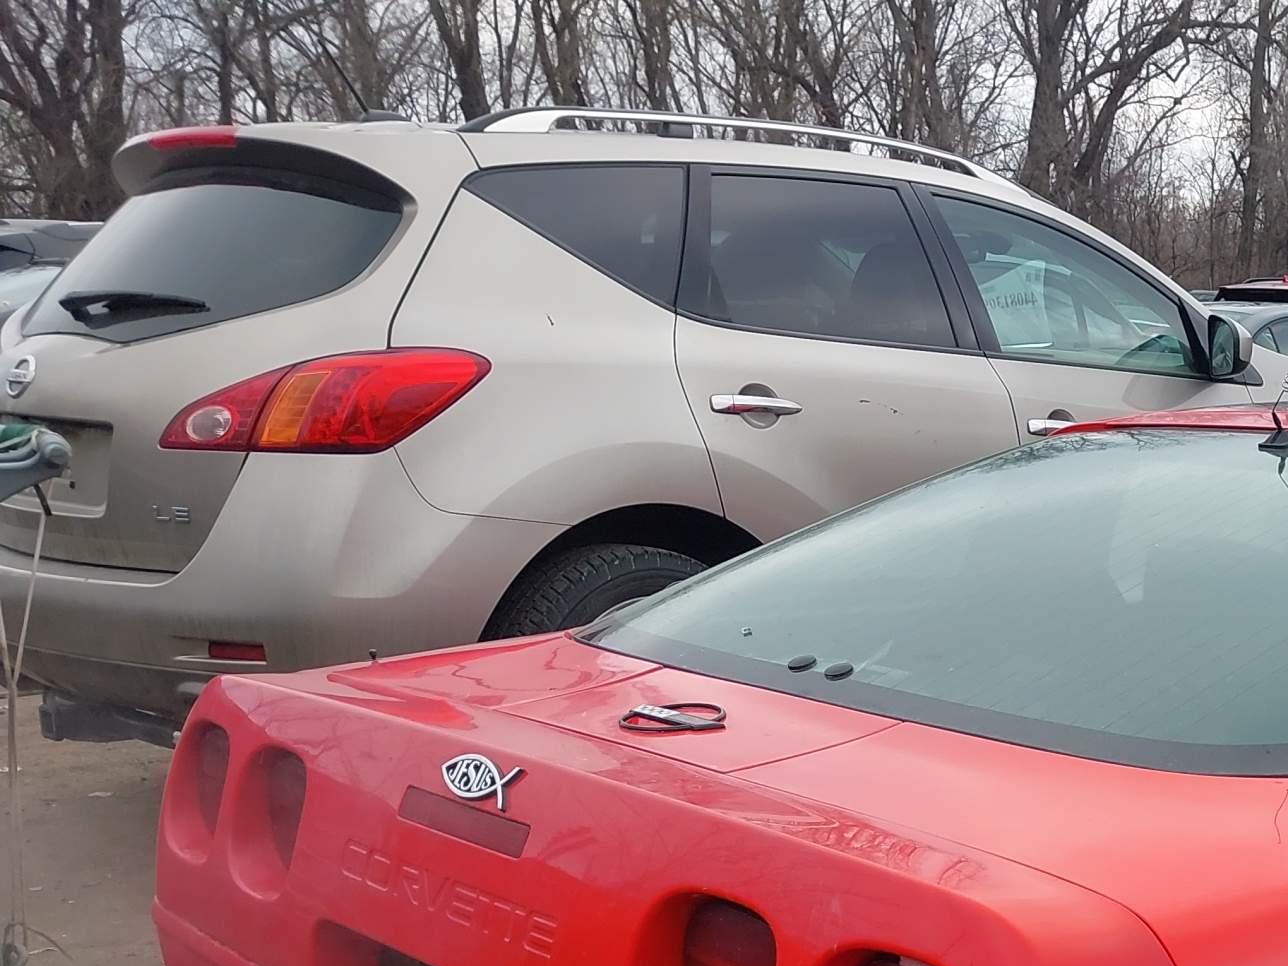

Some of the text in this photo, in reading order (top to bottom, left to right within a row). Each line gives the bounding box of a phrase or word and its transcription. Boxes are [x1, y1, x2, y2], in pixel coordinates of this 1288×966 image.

[152, 504, 190, 521] LE
[448, 759, 494, 793] JESUS
[340, 838, 559, 960] CORVETTE
